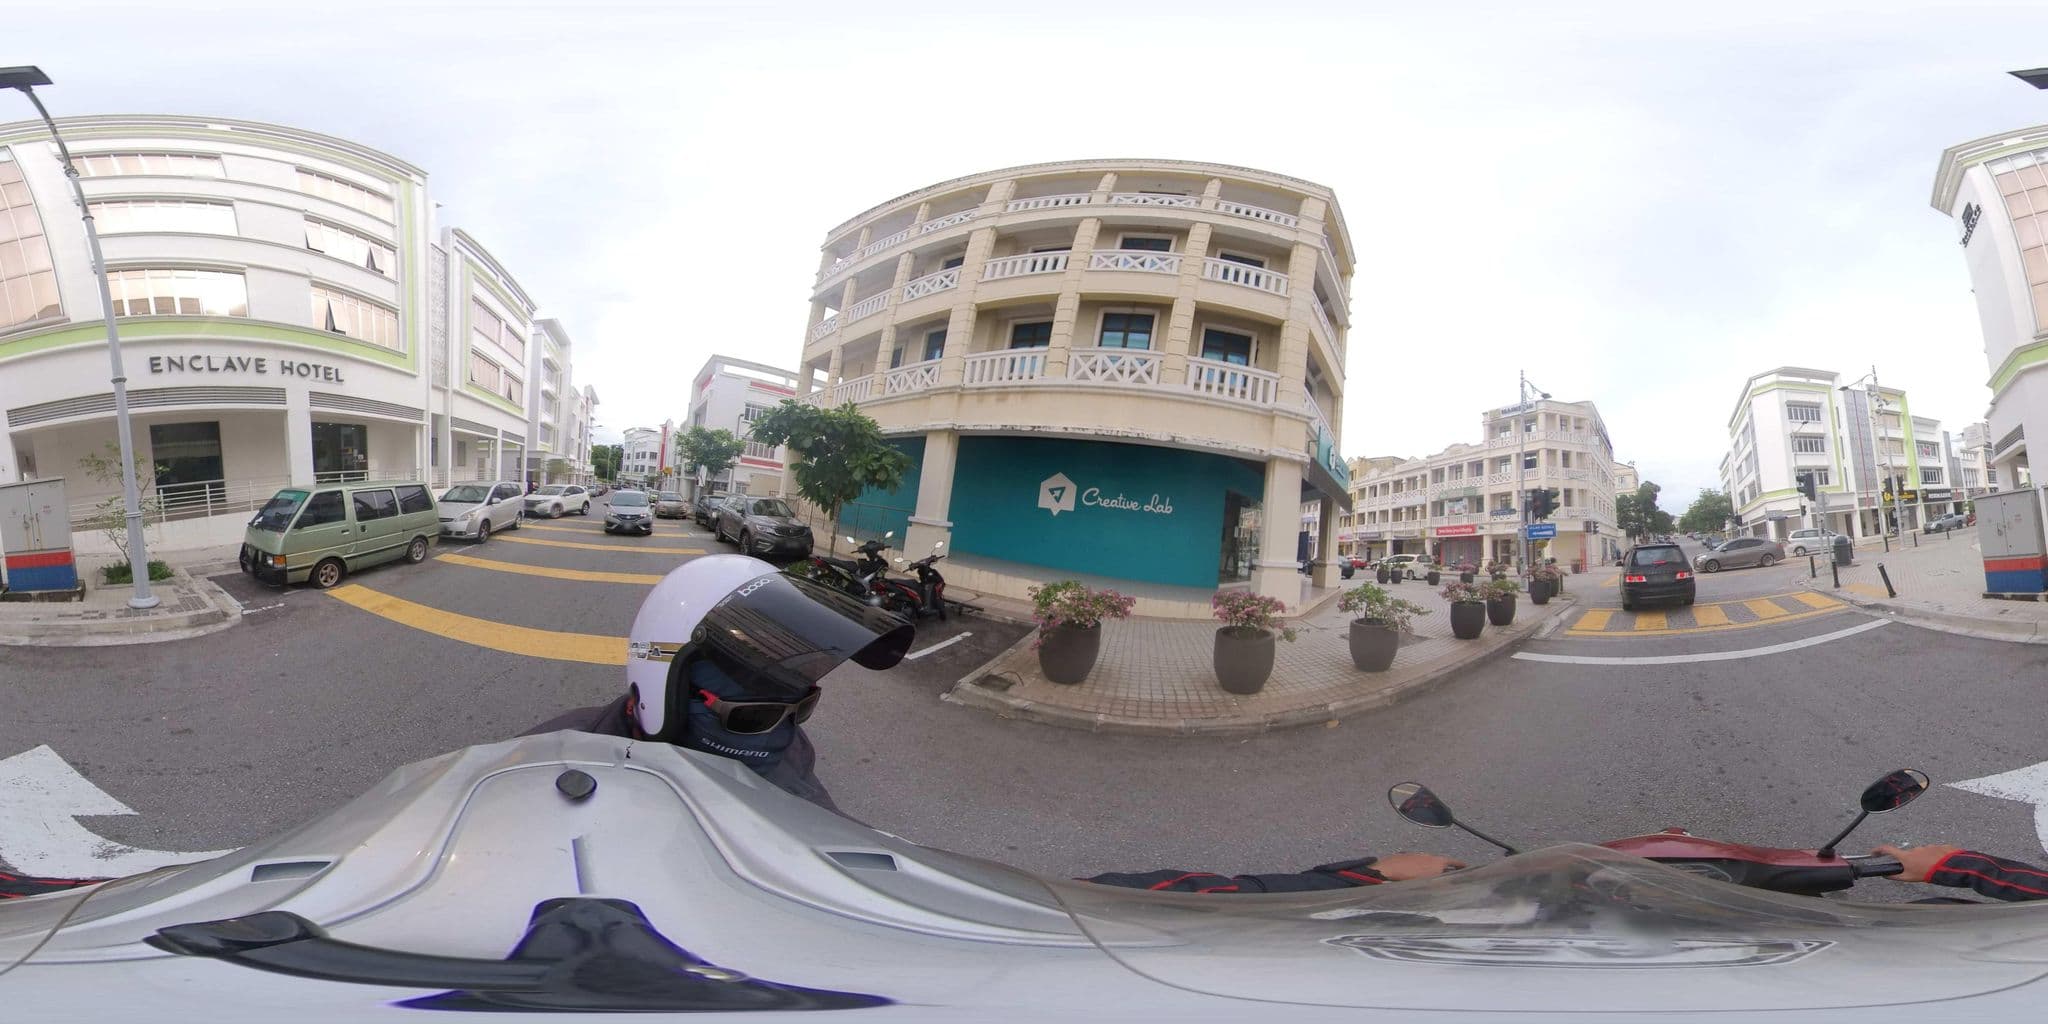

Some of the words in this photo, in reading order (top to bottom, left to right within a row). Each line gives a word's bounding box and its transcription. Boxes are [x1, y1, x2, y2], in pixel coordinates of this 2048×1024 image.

[149, 355, 267, 374] ENCLAVE
[281, 359, 345, 383] HOTEL
[1082, 487, 1141, 511] Creative
[1143, 493, 1173, 514] Lab
[701, 738, 769, 758] SHIMANO
